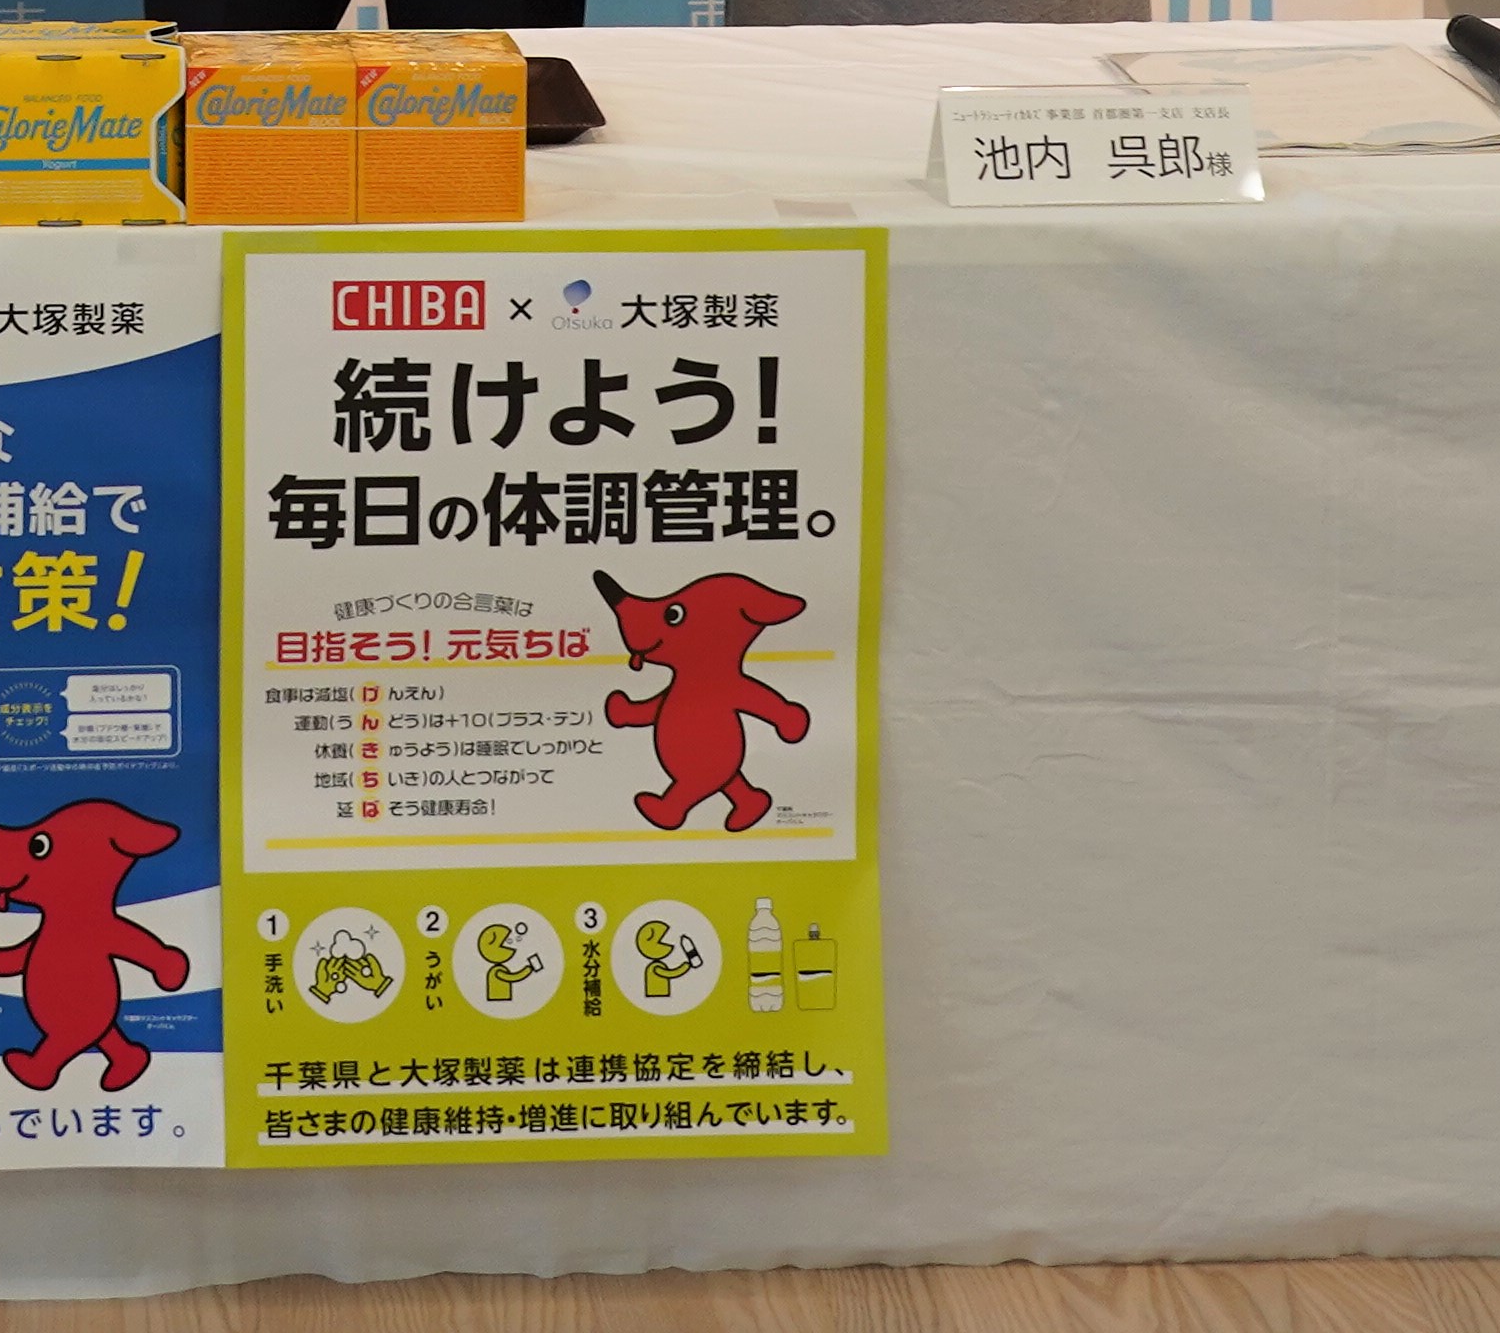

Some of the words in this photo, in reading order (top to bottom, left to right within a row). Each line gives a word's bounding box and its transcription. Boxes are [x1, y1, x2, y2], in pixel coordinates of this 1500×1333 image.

[23, 94, 73, 103] BALANCED
[77, 94, 103, 103] FOOD
[189, 70, 207, 87] NEW
[359, 70, 378, 87] NEW
[196, 83, 348, 126] CalorieMate
[367, 83, 518, 126] CalorieMate
[974, 134, 1071, 181] 池内
[337, 285, 481, 326] CHIBA
[551, 315, 613, 331] Otsuka
[621, 293, 779, 329] 大塚製薬
[333, 356, 779, 453] 続けよう!
[268, 468, 836, 550] 毎日の体調管理。
[334, 592, 535, 621] 健康づくりの合言葉は
[266, 914, 279, 936] 1
[426, 911, 440, 932] 2
[583, 908, 599, 929] 3
[264, 953, 284, 1014] 手洗い
[425, 950, 444, 1011] うがい
[583, 939, 602, 1017] 水分補給
[264, 1100, 847, 1139] 皆さまの健康維持・増進に取り組んでいます。
